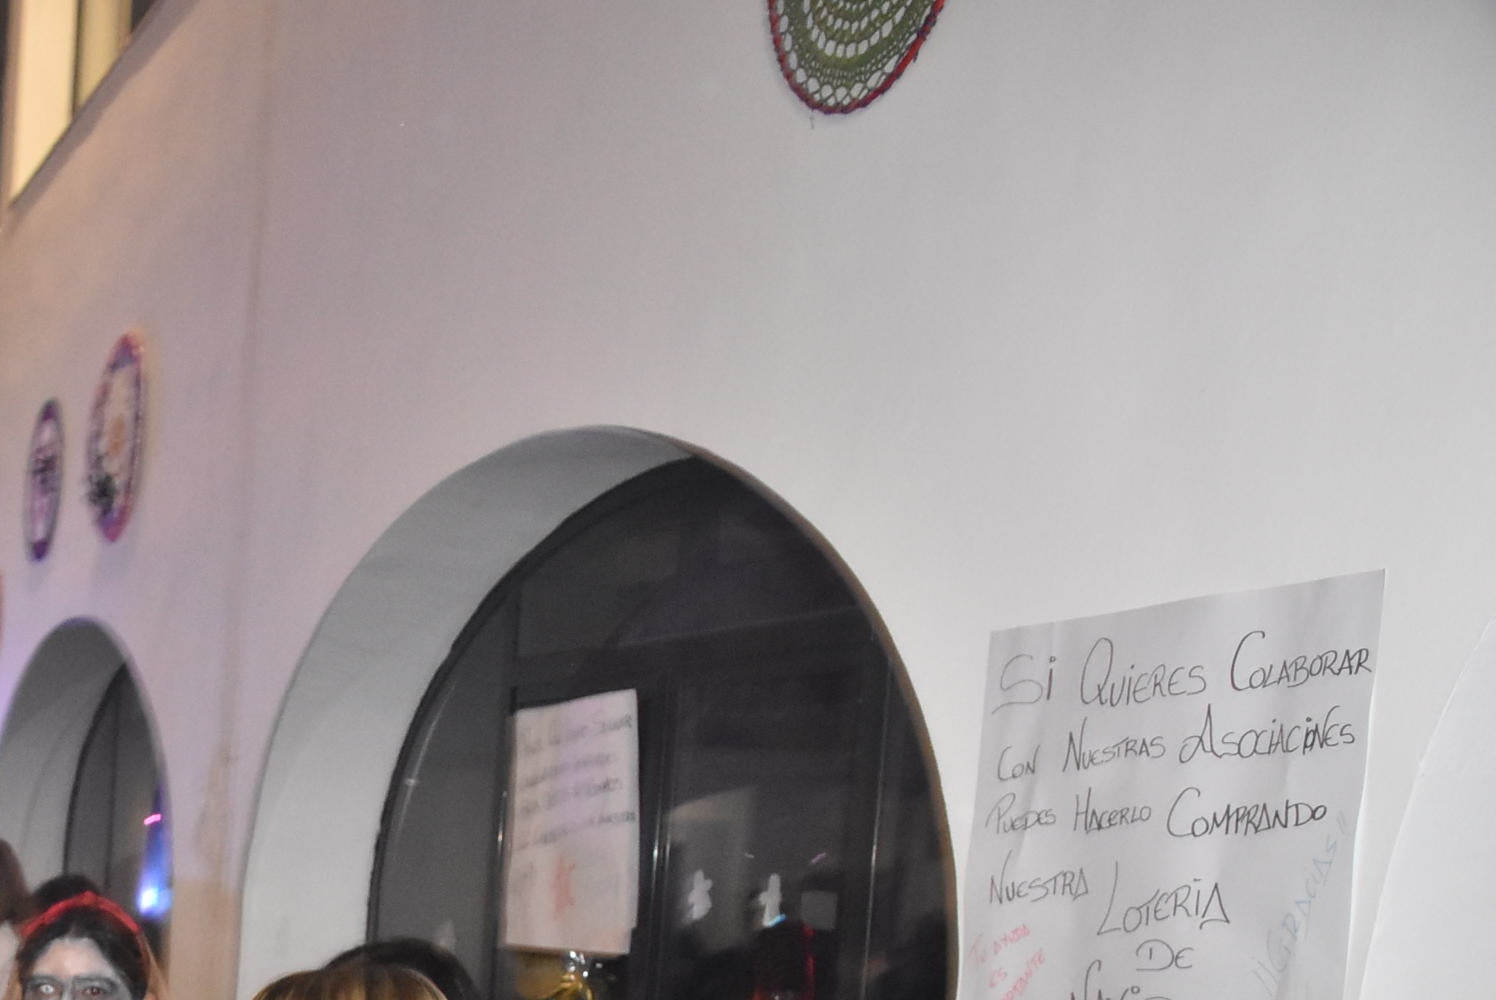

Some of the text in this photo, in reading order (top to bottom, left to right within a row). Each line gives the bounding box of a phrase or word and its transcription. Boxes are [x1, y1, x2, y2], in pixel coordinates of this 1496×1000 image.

[1230, 630, 1373, 692] COLABORAR
[997, 745, 1040, 782] CON
[1062, 716, 1167, 773] NUESTRAS
[985, 786, 1328, 837] PUEDES HACERLO COMPRANDO
[989, 849, 1090, 904] NUESTRA
[1135, 938, 1194, 972] DE
